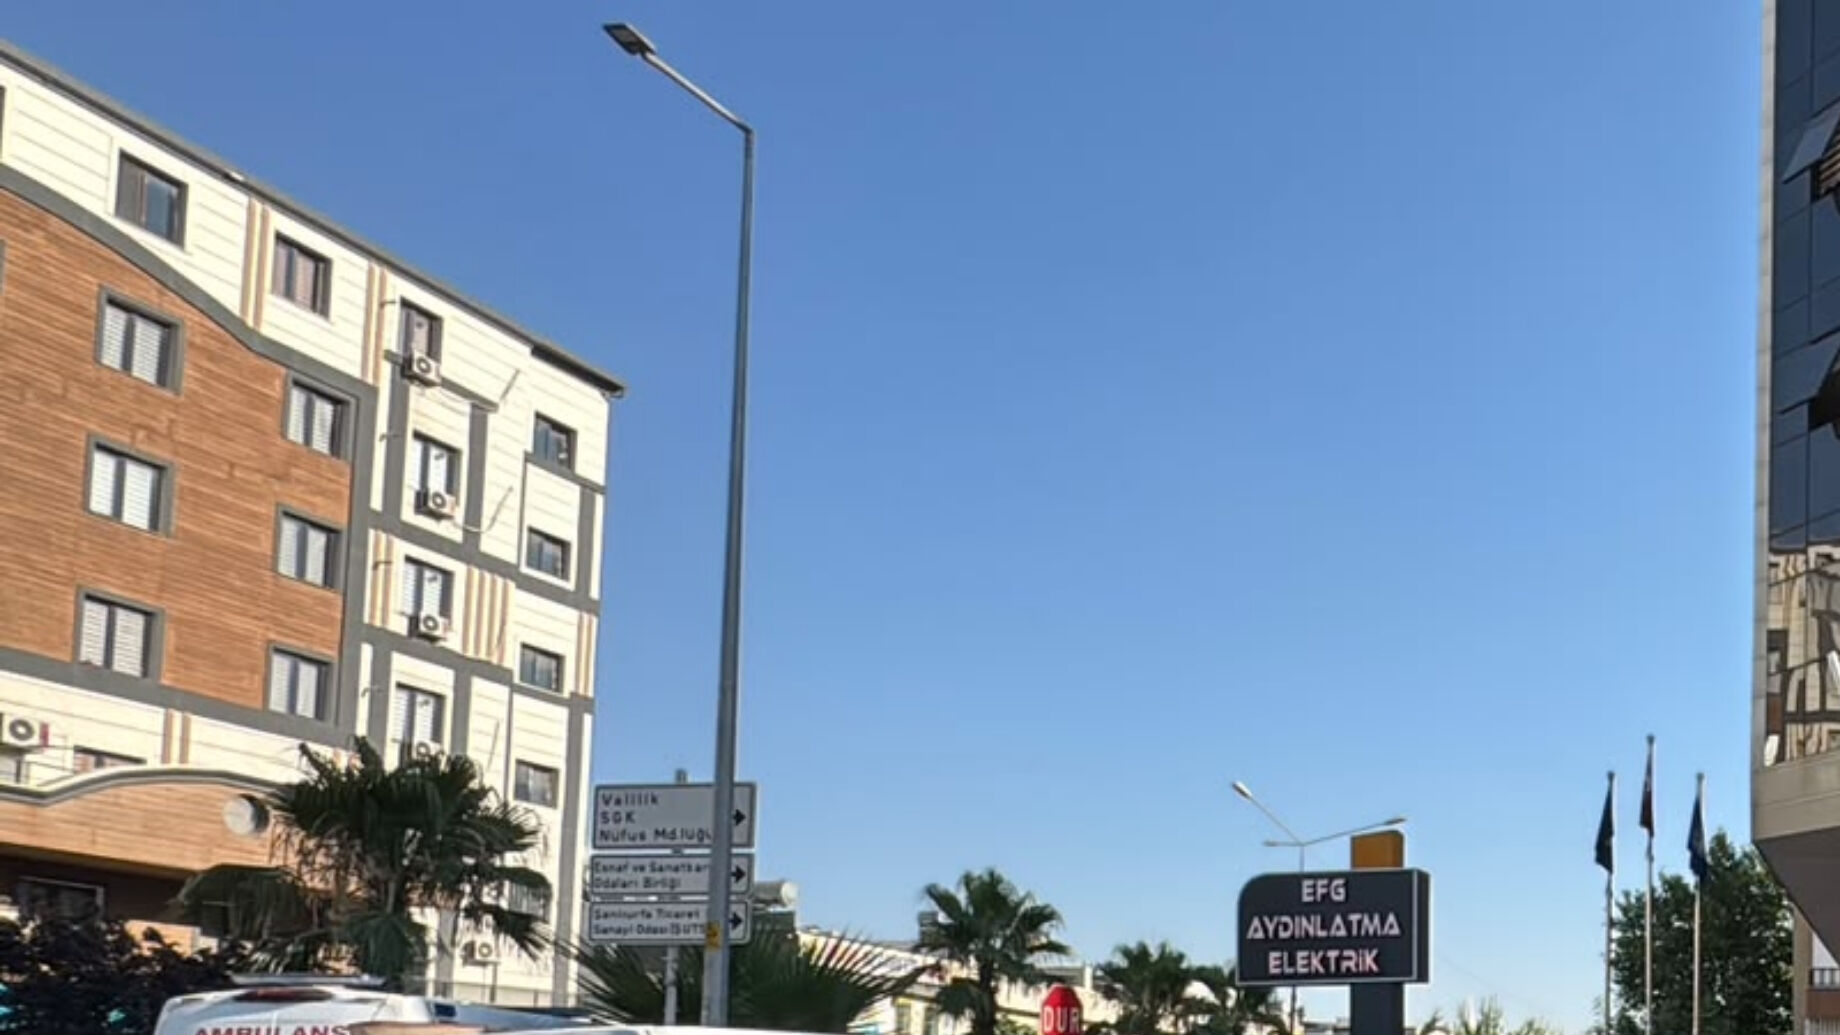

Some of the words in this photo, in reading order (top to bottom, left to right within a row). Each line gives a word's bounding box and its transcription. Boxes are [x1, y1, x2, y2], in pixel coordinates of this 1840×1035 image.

[601, 793, 659, 806] Valilik
[600, 811, 636, 824] SGK
[631, 864, 646, 873] ve
[1301, 878, 1347, 902] EFG
[1246, 912, 1401, 940] AYDINLATMA
[1043, 1006, 1080, 1034] DUR
